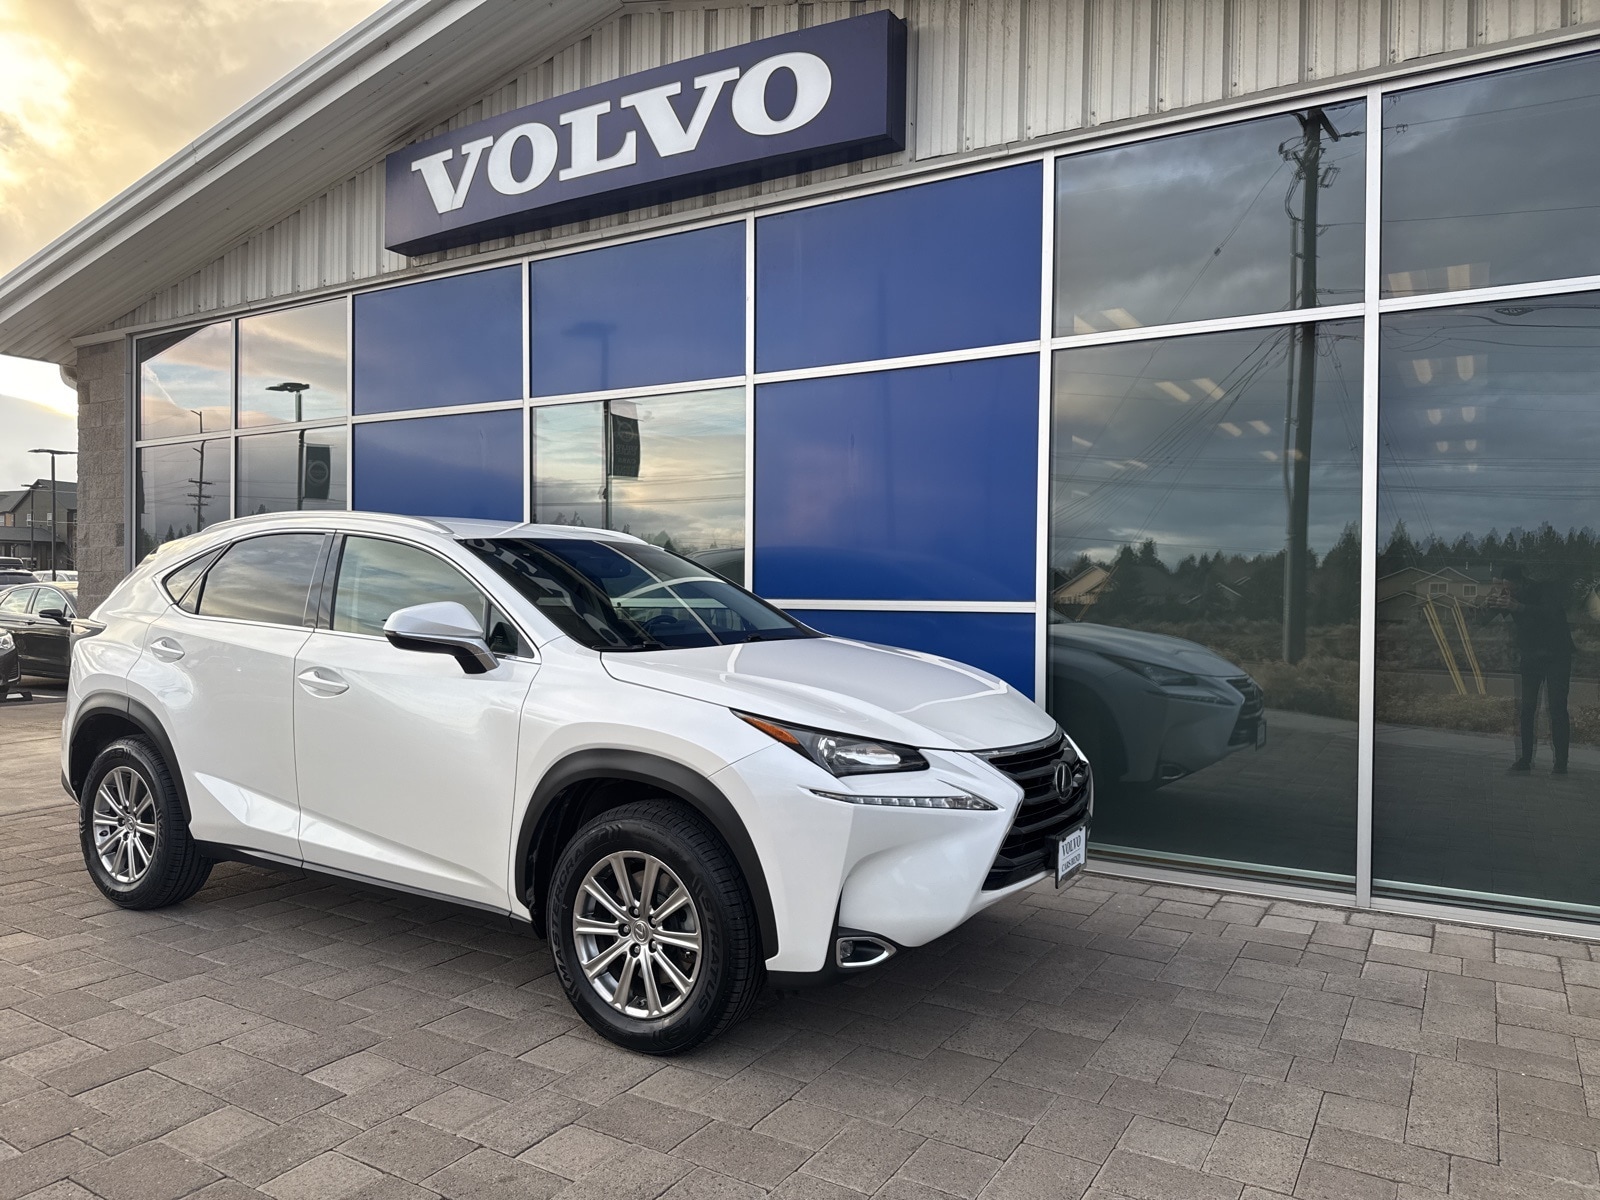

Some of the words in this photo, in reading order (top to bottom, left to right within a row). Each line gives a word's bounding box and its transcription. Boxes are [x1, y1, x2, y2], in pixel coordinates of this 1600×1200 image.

[411, 51, 832, 214] VOLVO
[551, 827, 606, 983] MASTERCRAFT
[1061, 835, 1081, 856] VOLVO
[700, 894, 722, 1014] STRATUS
